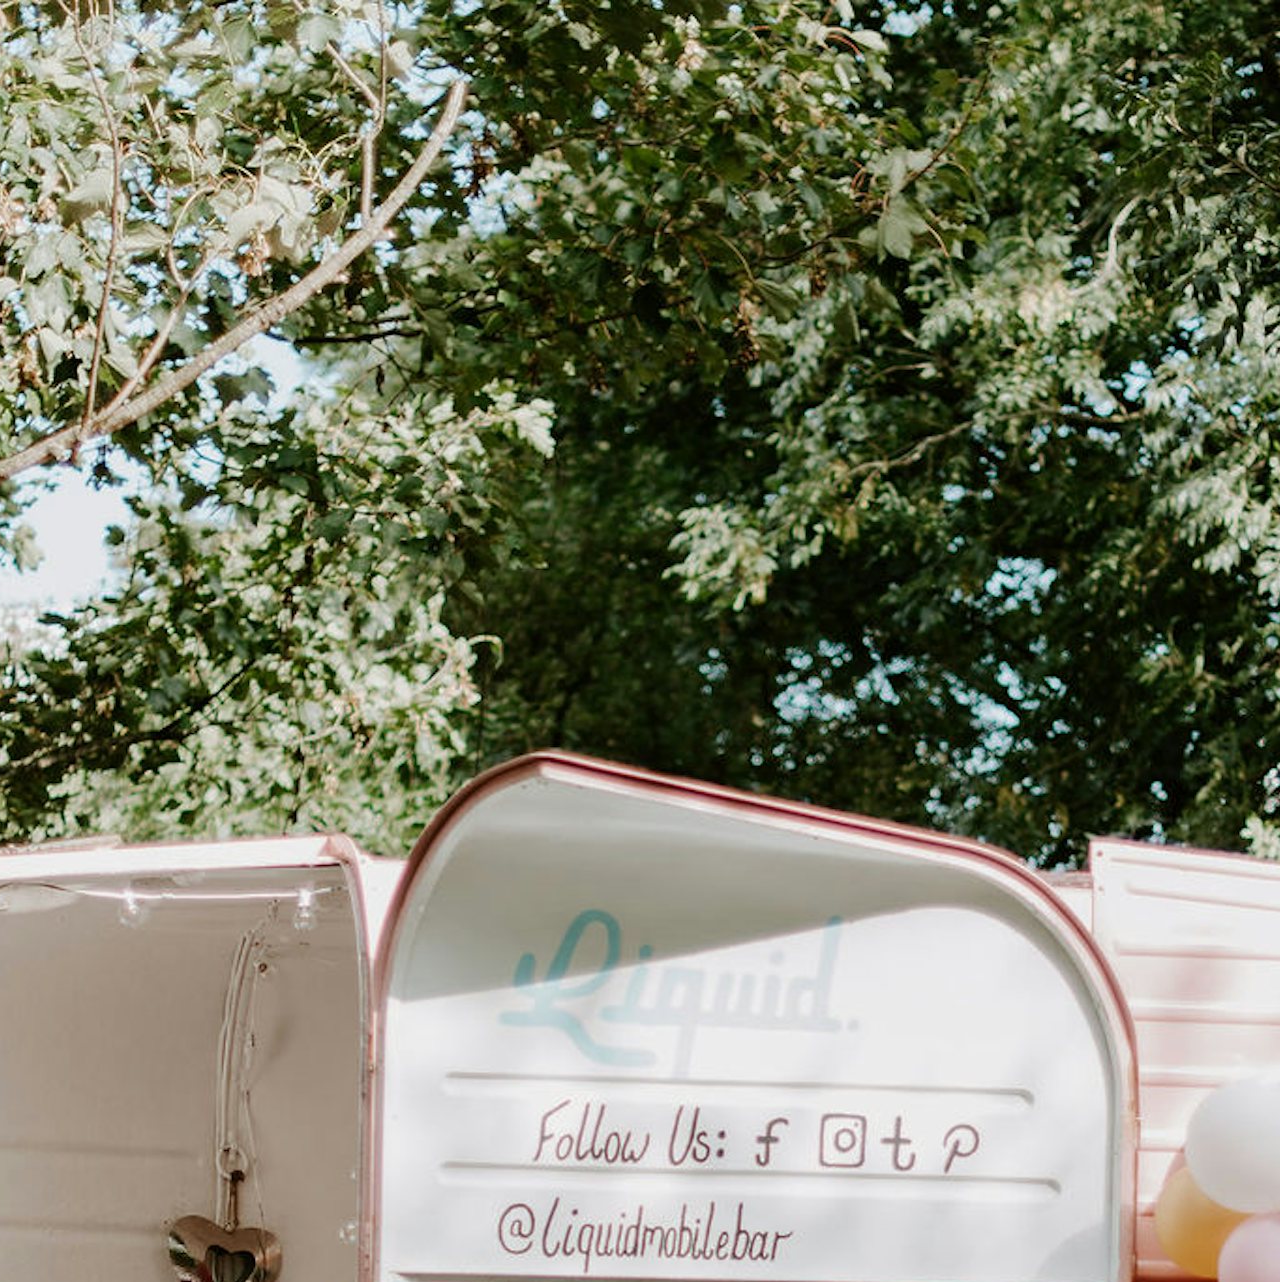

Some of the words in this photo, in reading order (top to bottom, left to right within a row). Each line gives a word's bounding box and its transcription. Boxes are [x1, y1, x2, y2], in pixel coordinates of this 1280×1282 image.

[533, 1101, 650, 1162] Follow
[668, 1106, 727, 1164] Us:
[498, 1198, 794, 1273] @liquidmobilebar
